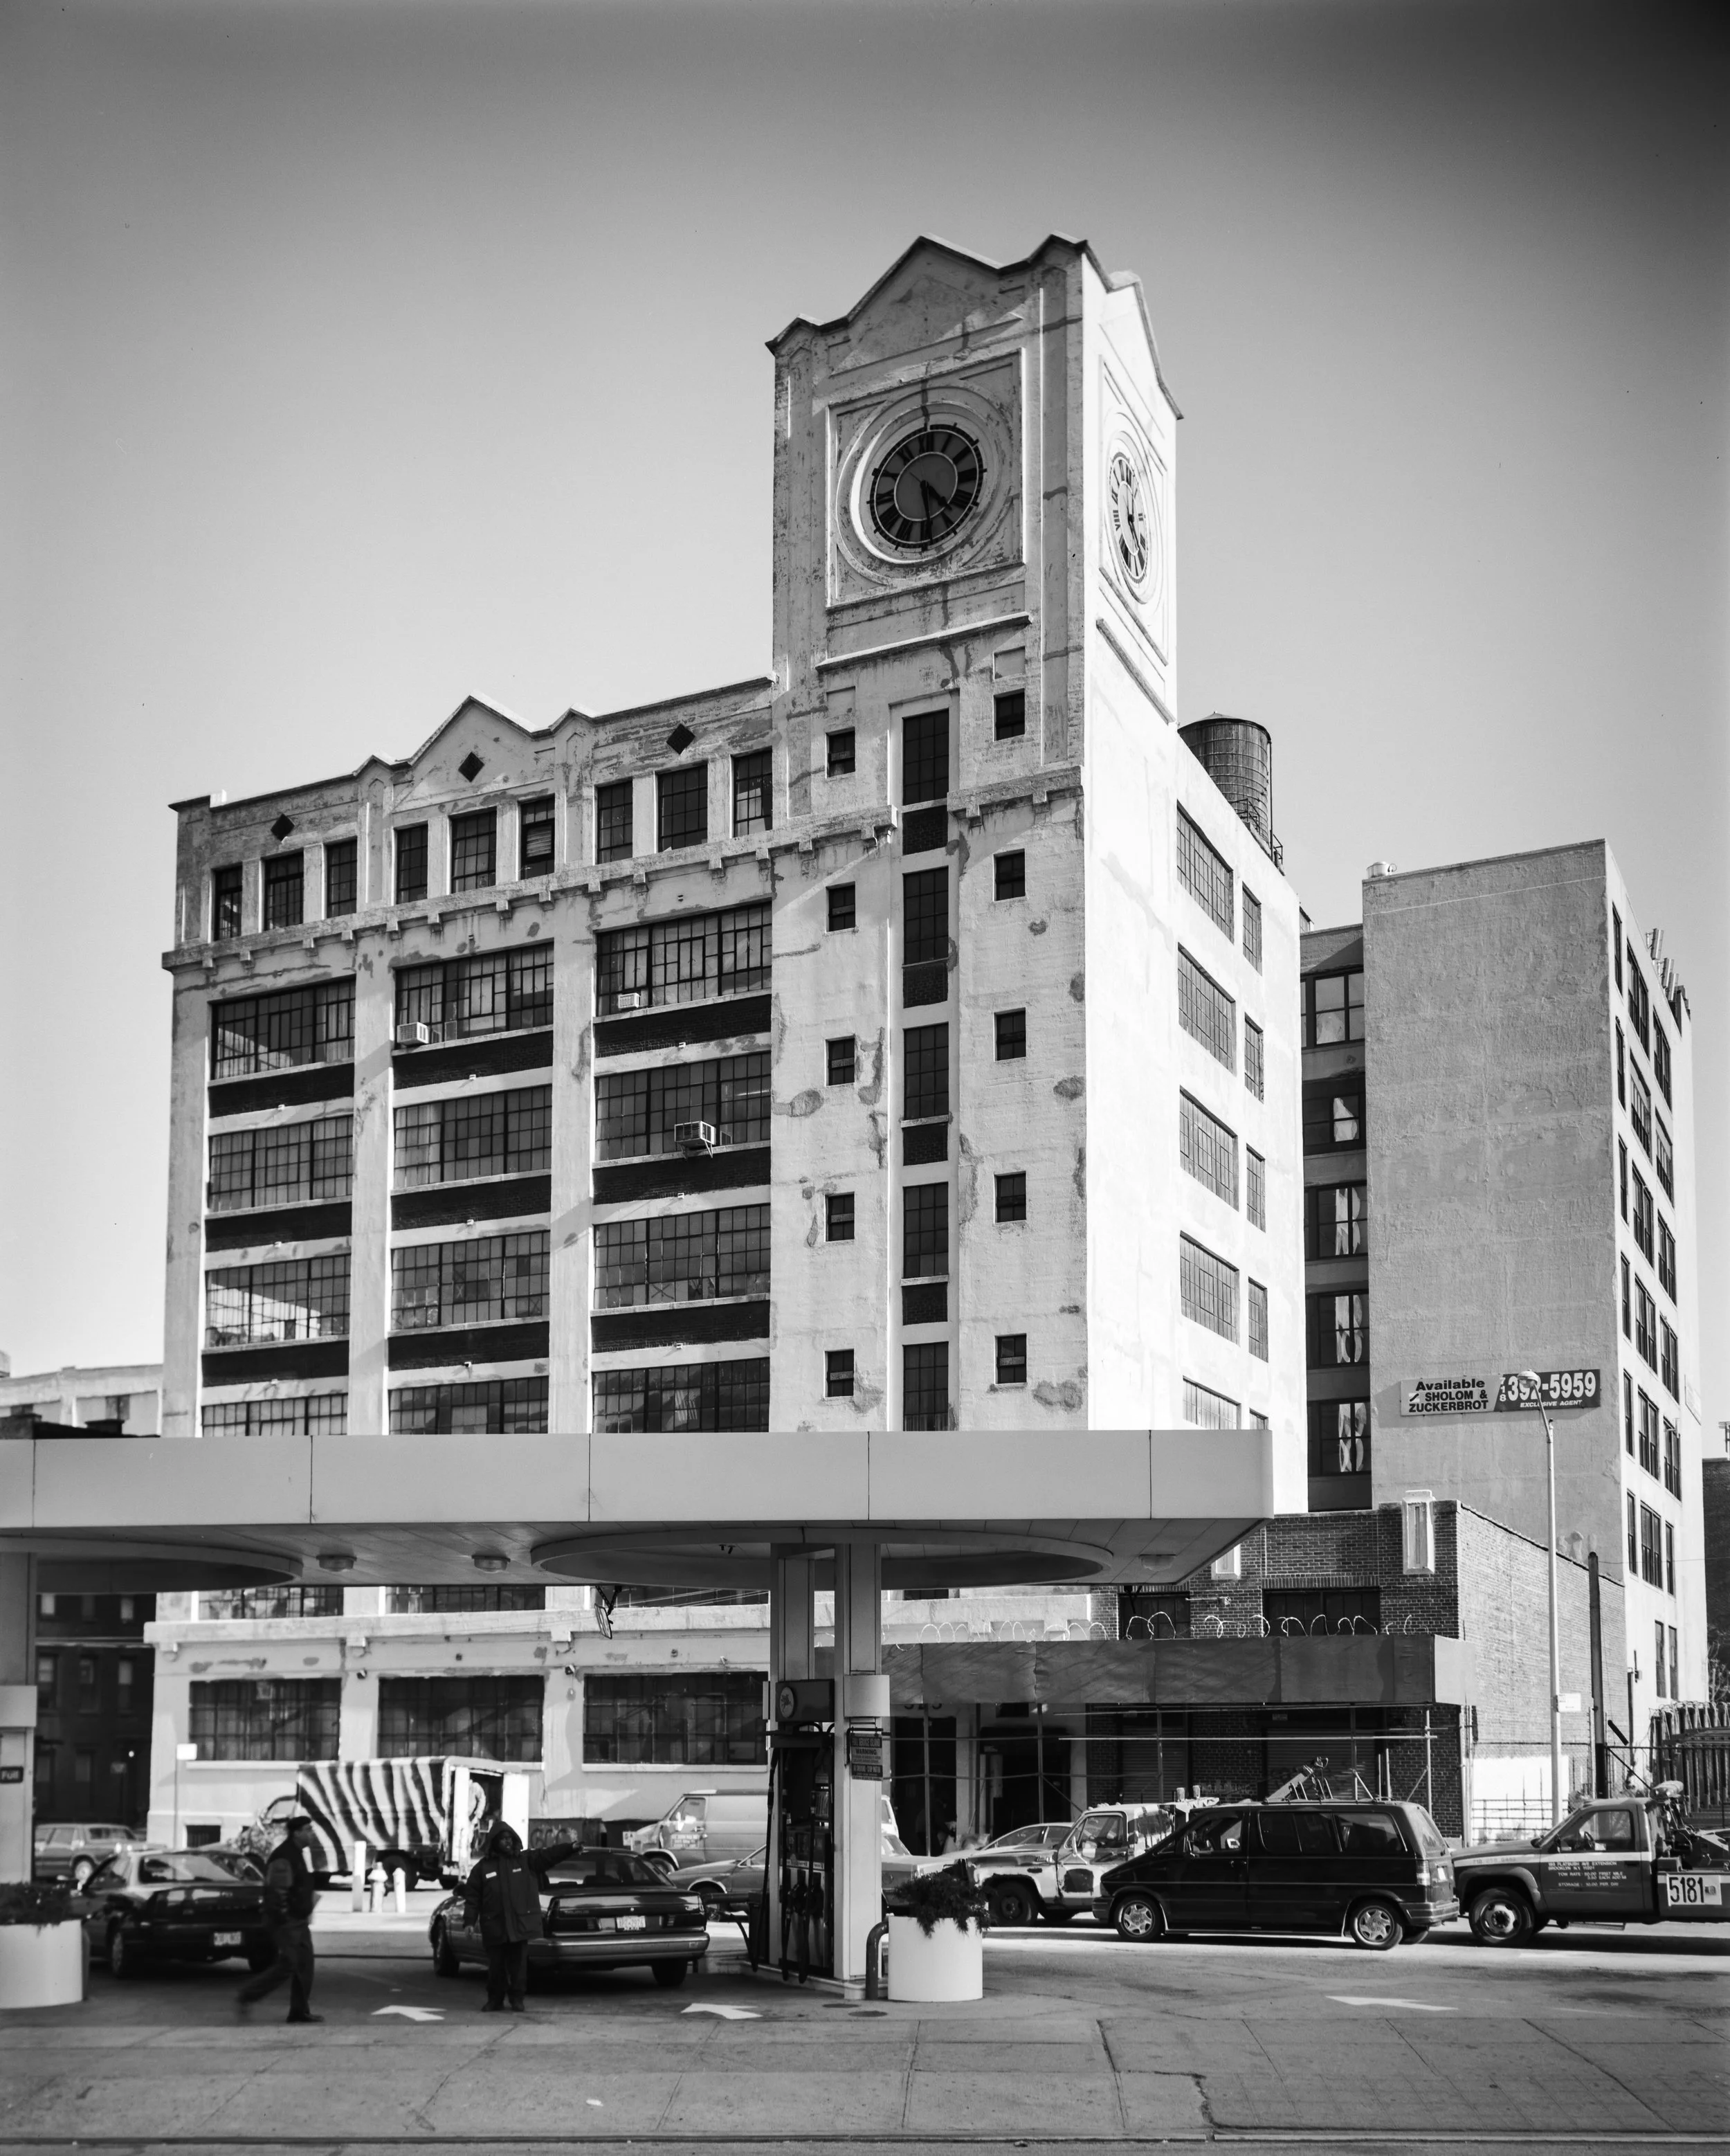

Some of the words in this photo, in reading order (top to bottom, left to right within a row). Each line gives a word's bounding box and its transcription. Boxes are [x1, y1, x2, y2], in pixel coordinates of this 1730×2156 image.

[1415, 1378, 1485, 1391] Available
[1425, 1390, 1473, 1402] SHOLOM
[1479, 1389, 1488, 1399] &
[1409, 1399, 1488, 1413] ZUCKERBROT
[1668, 1876, 1704, 1903] 5181
